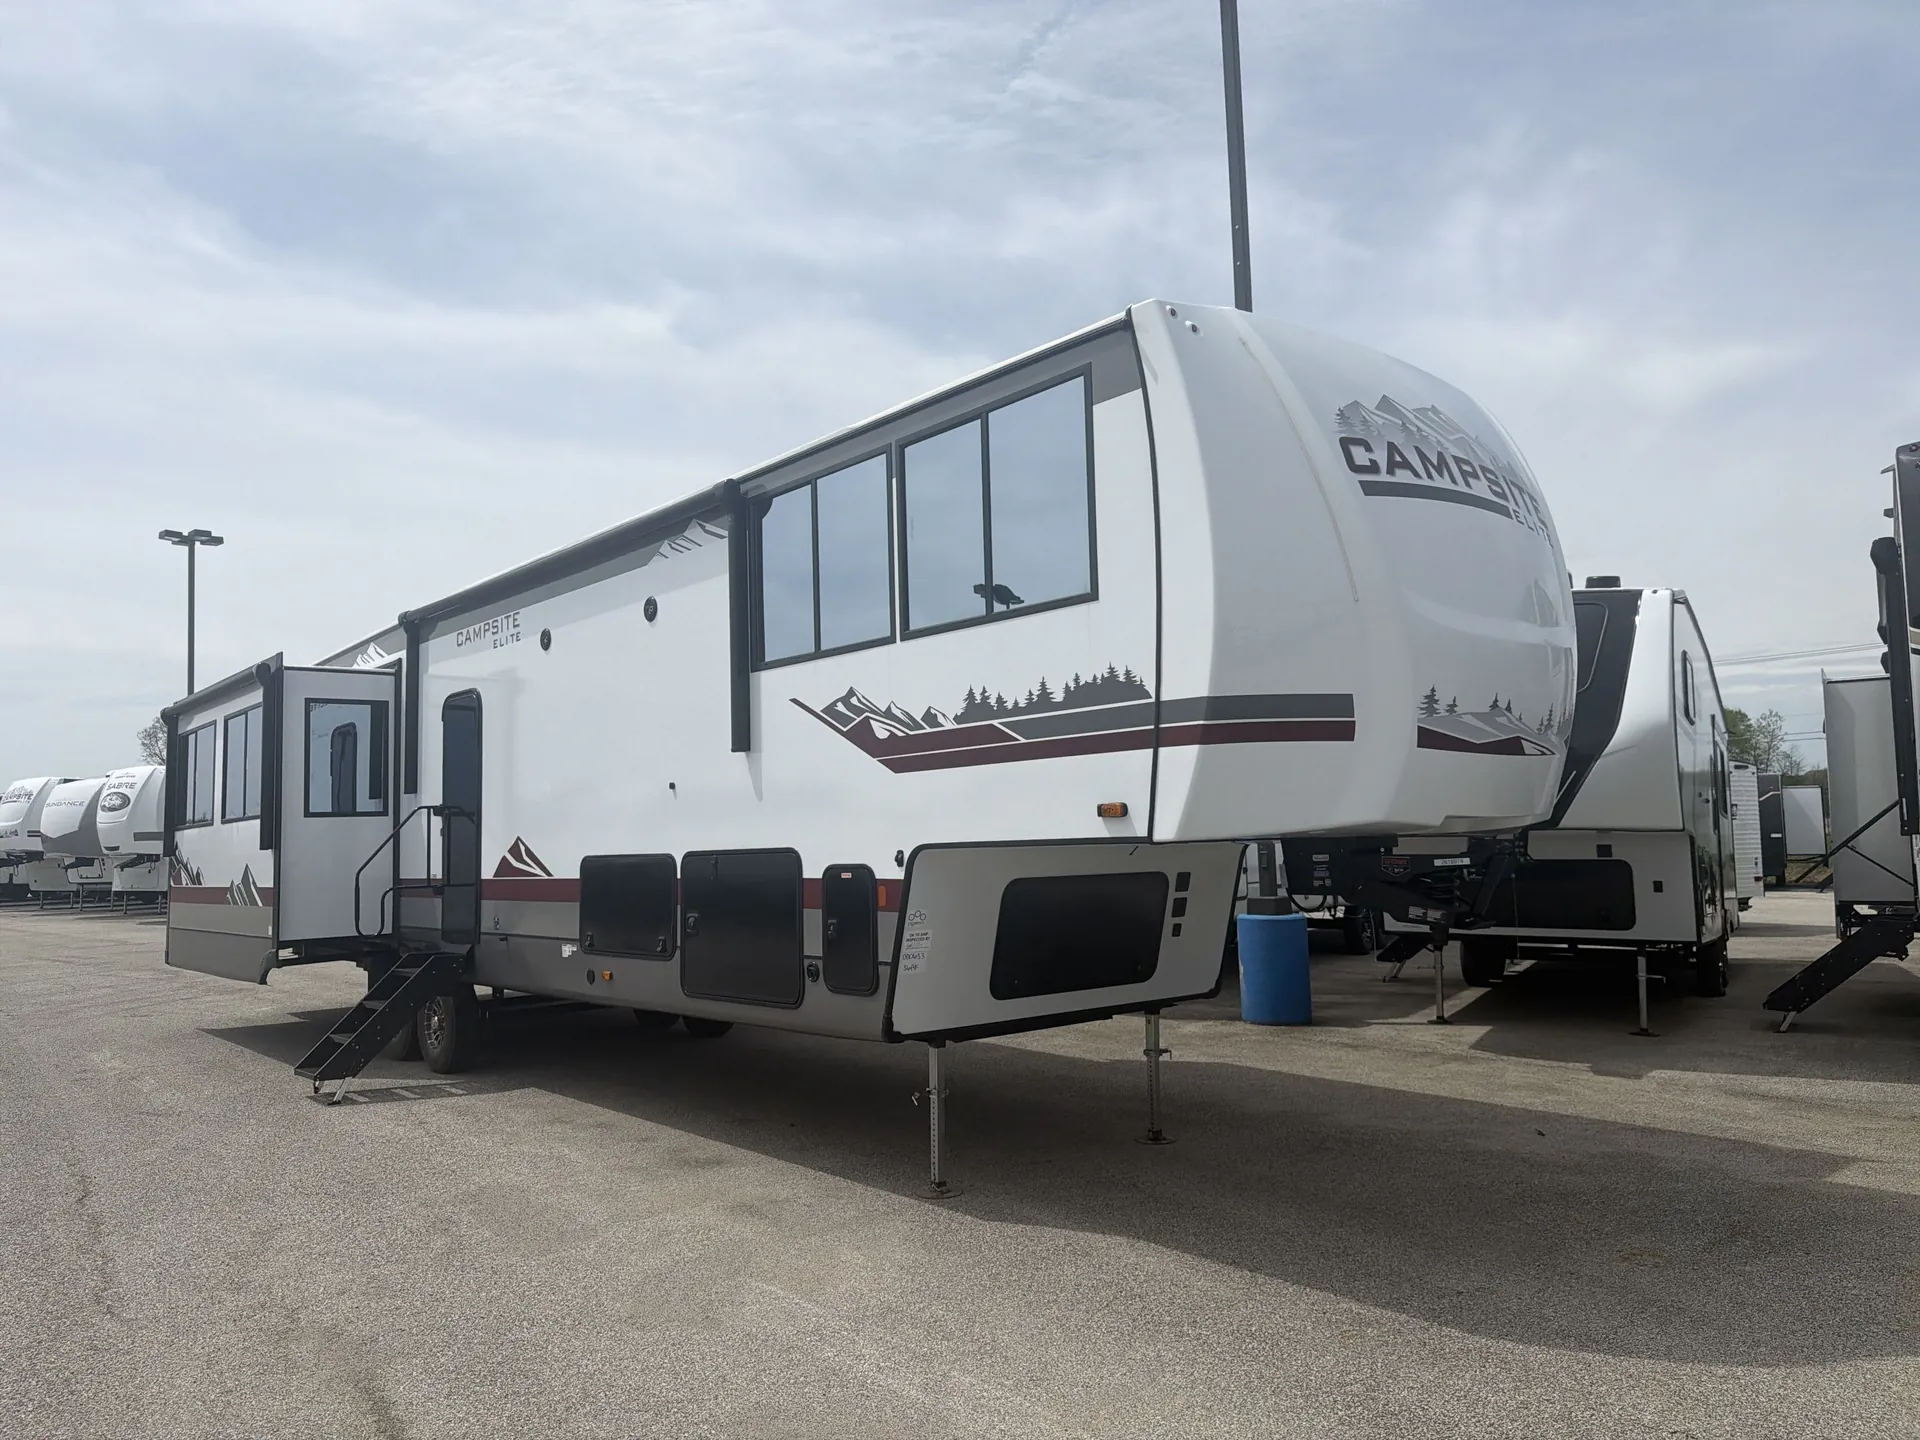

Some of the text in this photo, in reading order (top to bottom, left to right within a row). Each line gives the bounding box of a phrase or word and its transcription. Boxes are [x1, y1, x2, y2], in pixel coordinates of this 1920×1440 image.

[1339, 436, 1548, 531] CAMPSITE
[456, 611, 520, 647] CAMPSITE
[493, 631, 521, 649] ELITE
[106, 782, 137, 790] SABRE
